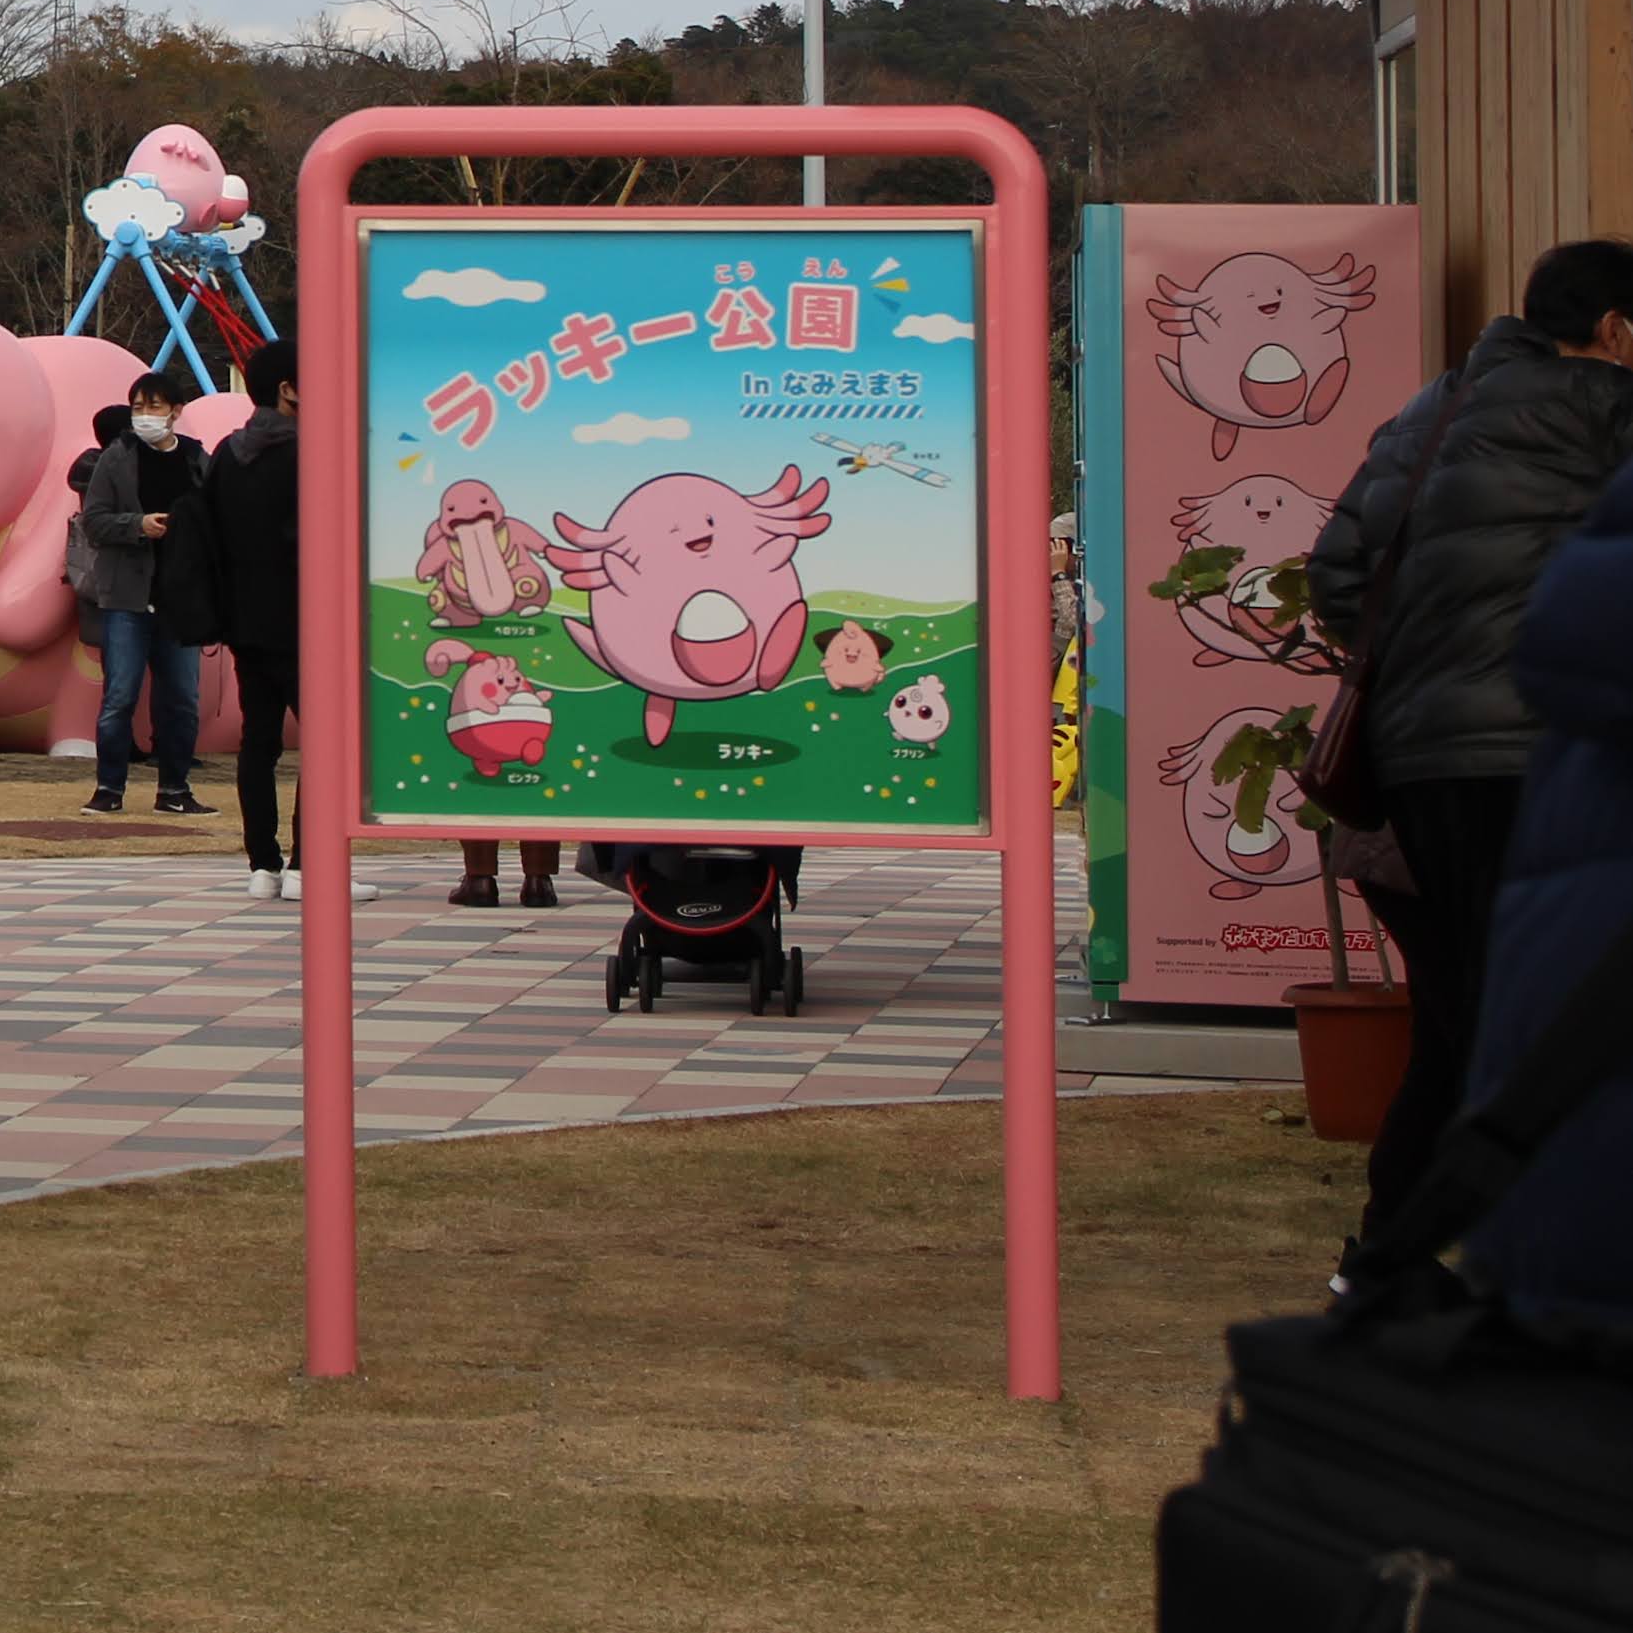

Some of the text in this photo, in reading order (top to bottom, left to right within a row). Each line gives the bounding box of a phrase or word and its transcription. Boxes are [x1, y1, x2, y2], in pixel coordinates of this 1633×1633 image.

[714, 257, 847, 283] こう えん
[423, 282, 858, 449] ラッキー公園
[743, 371, 920, 396] In なみえまち
[718, 744, 773, 760] ラッキー
[1156, 924, 1388, 950] Supported by ポケモンだいすクラ
